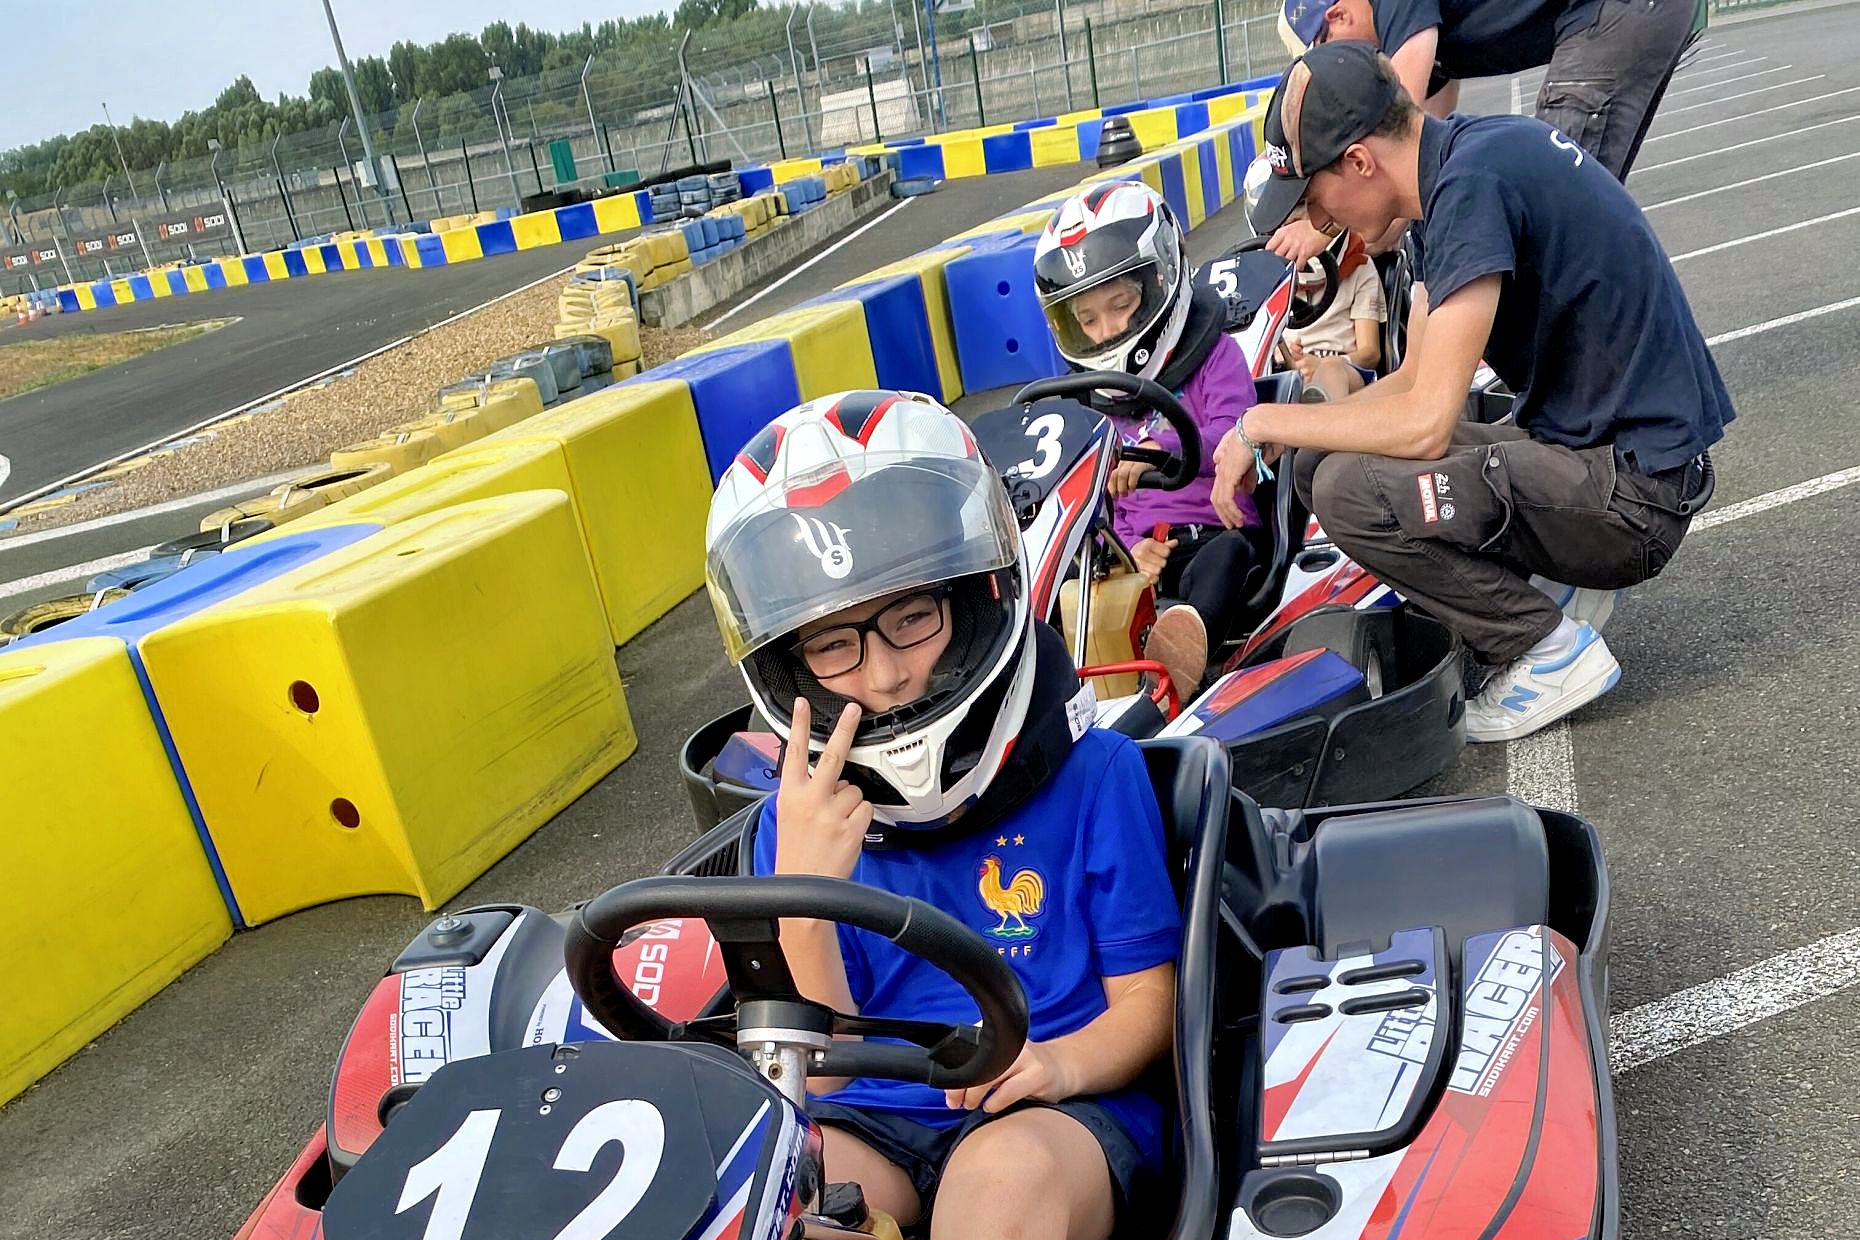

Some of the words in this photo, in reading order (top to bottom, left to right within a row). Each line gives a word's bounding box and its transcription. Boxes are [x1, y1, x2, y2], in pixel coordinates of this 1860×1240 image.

[1208, 258, 1238, 299] 5
[1137, 350, 1148, 361] XS
[1018, 413, 1065, 480] 3
[1420, 477, 1437, 520] MOTUL
[831, 550, 844, 566] S
[1500, 685, 1542, 714] N
[998, 945, 1032, 958] FFF
[632, 943, 669, 1011] SOD
[1366, 985, 1438, 1055] Litt
